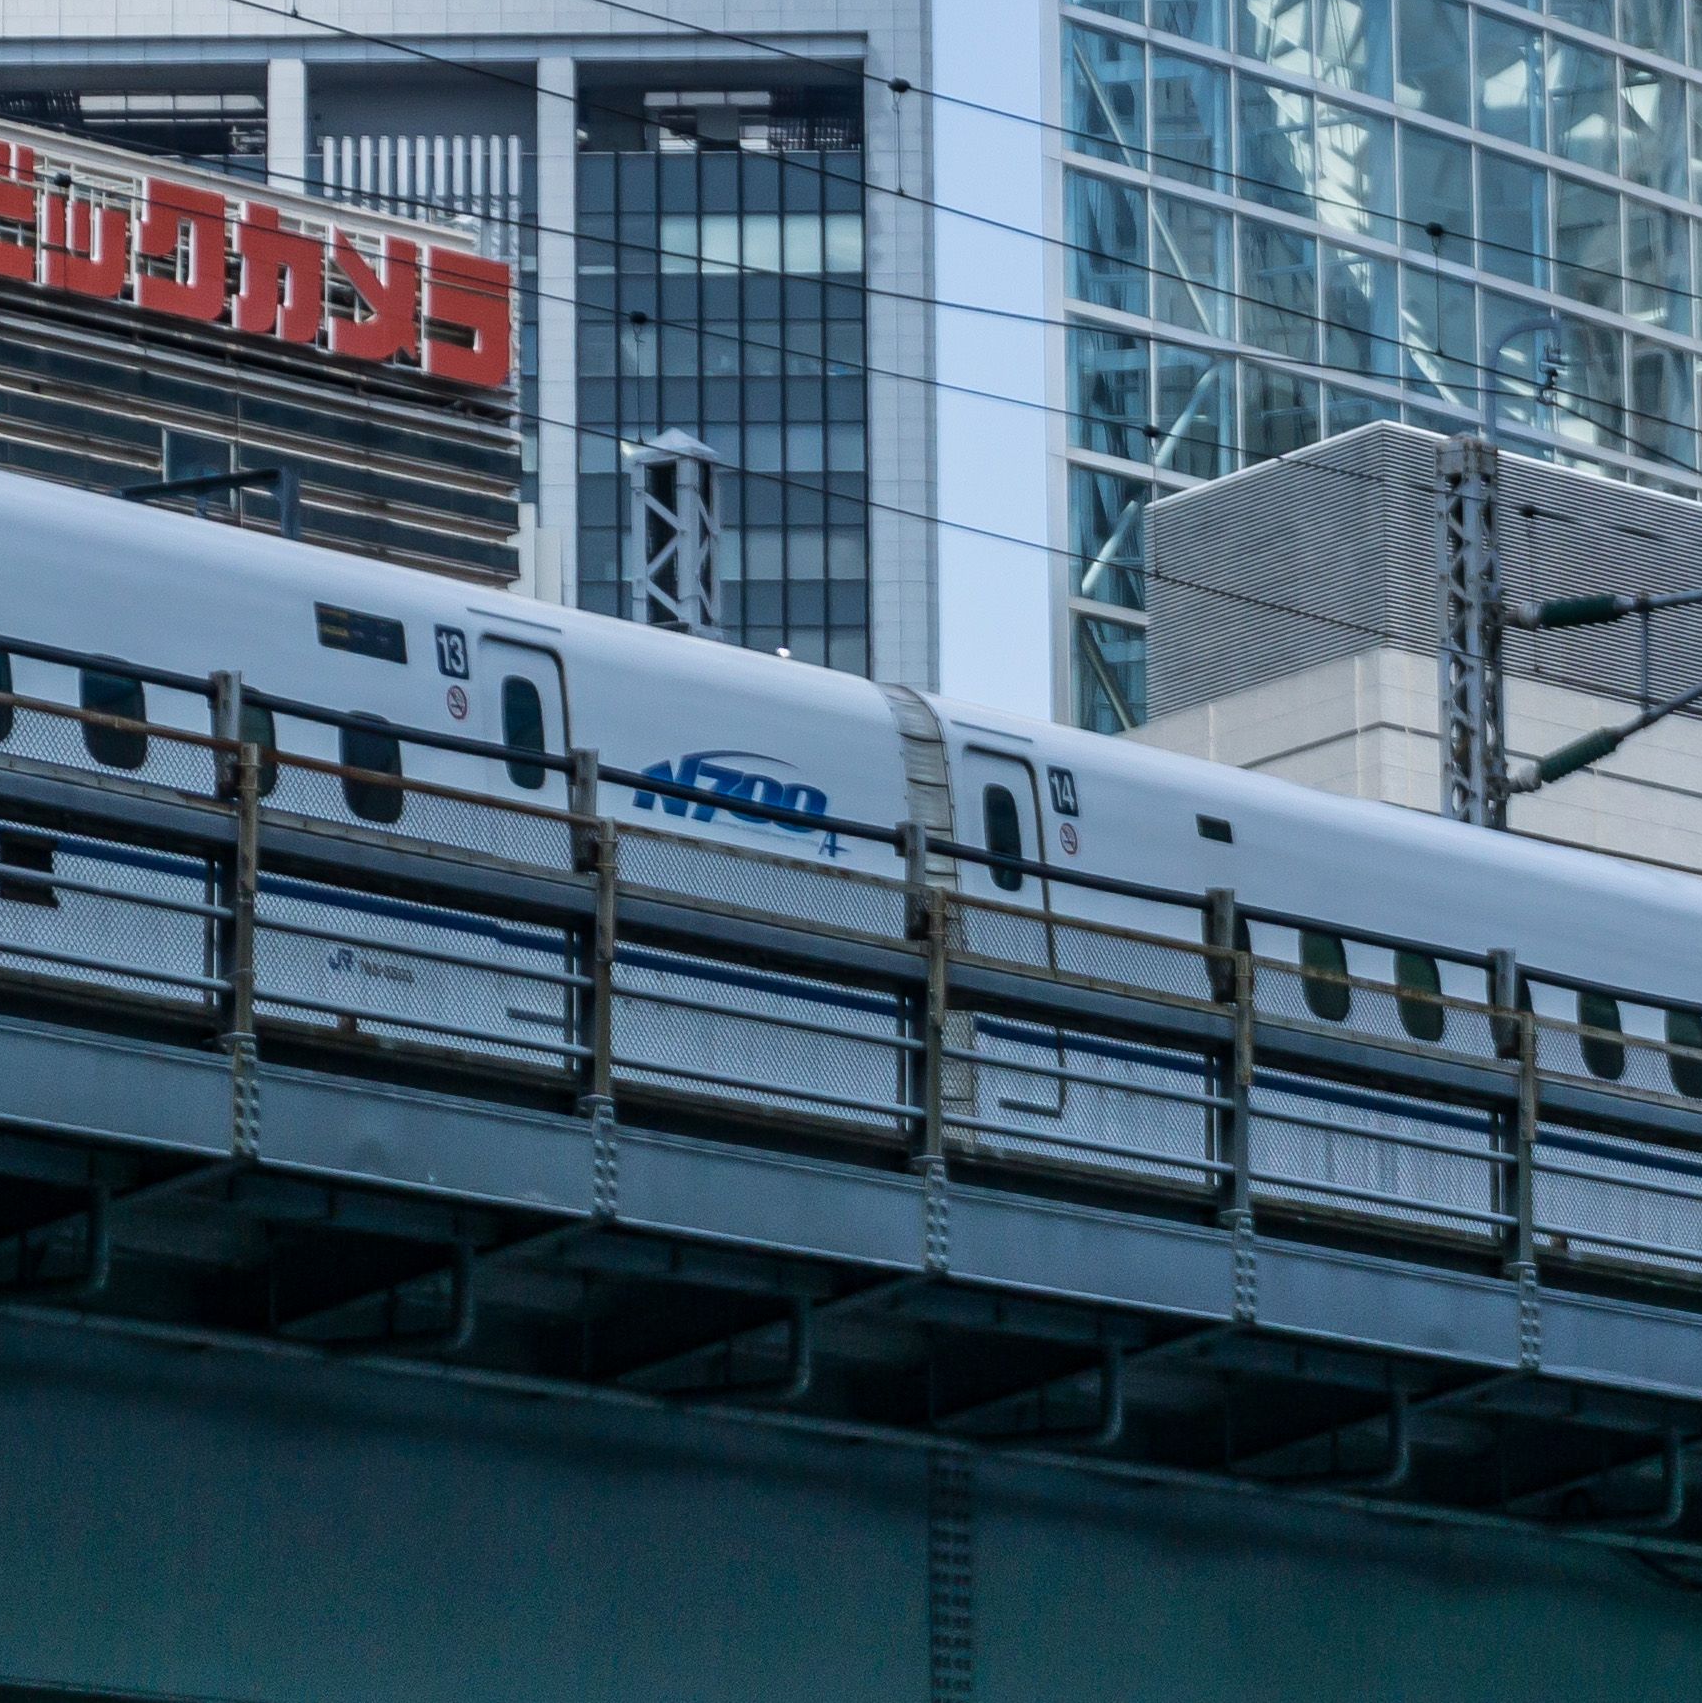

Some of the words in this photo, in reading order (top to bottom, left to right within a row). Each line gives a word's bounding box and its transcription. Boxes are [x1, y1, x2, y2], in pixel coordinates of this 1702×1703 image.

[437, 631, 465, 674] 13
[632, 750, 828, 834] N700
[1049, 770, 1075, 810] 14
